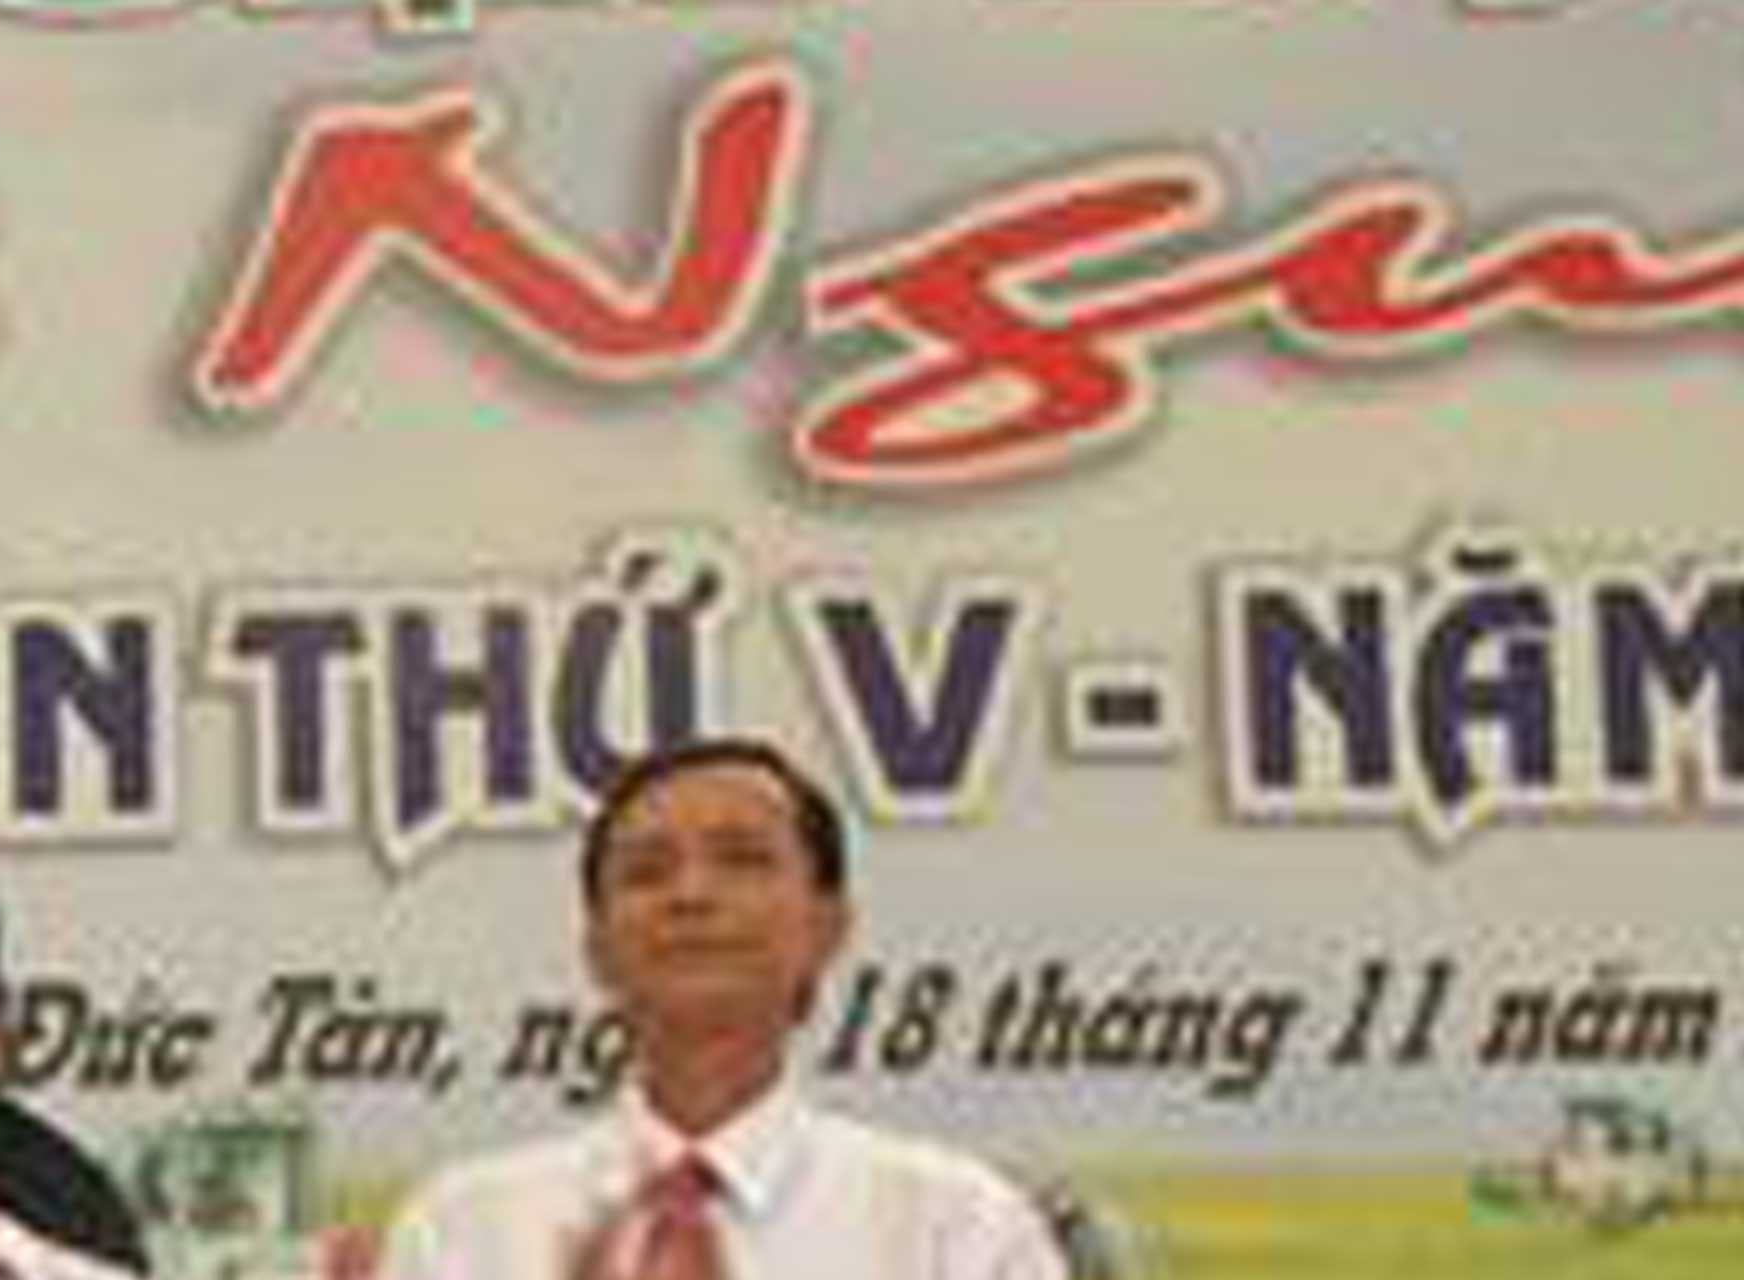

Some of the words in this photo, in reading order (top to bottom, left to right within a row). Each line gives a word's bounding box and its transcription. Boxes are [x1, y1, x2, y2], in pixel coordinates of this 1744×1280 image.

[230, 546, 722, 828] THỨ
[816, 598, 1018, 790] V
[1242, 548, 1744, 804] NĂM
[498, 1002, 636, 1106] ng
[818, 962, 958, 1076] 18
[972, 959, 1304, 1102] tháng
[1327, 956, 1458, 1068] 11
[1475, 960, 1726, 1068] năm
